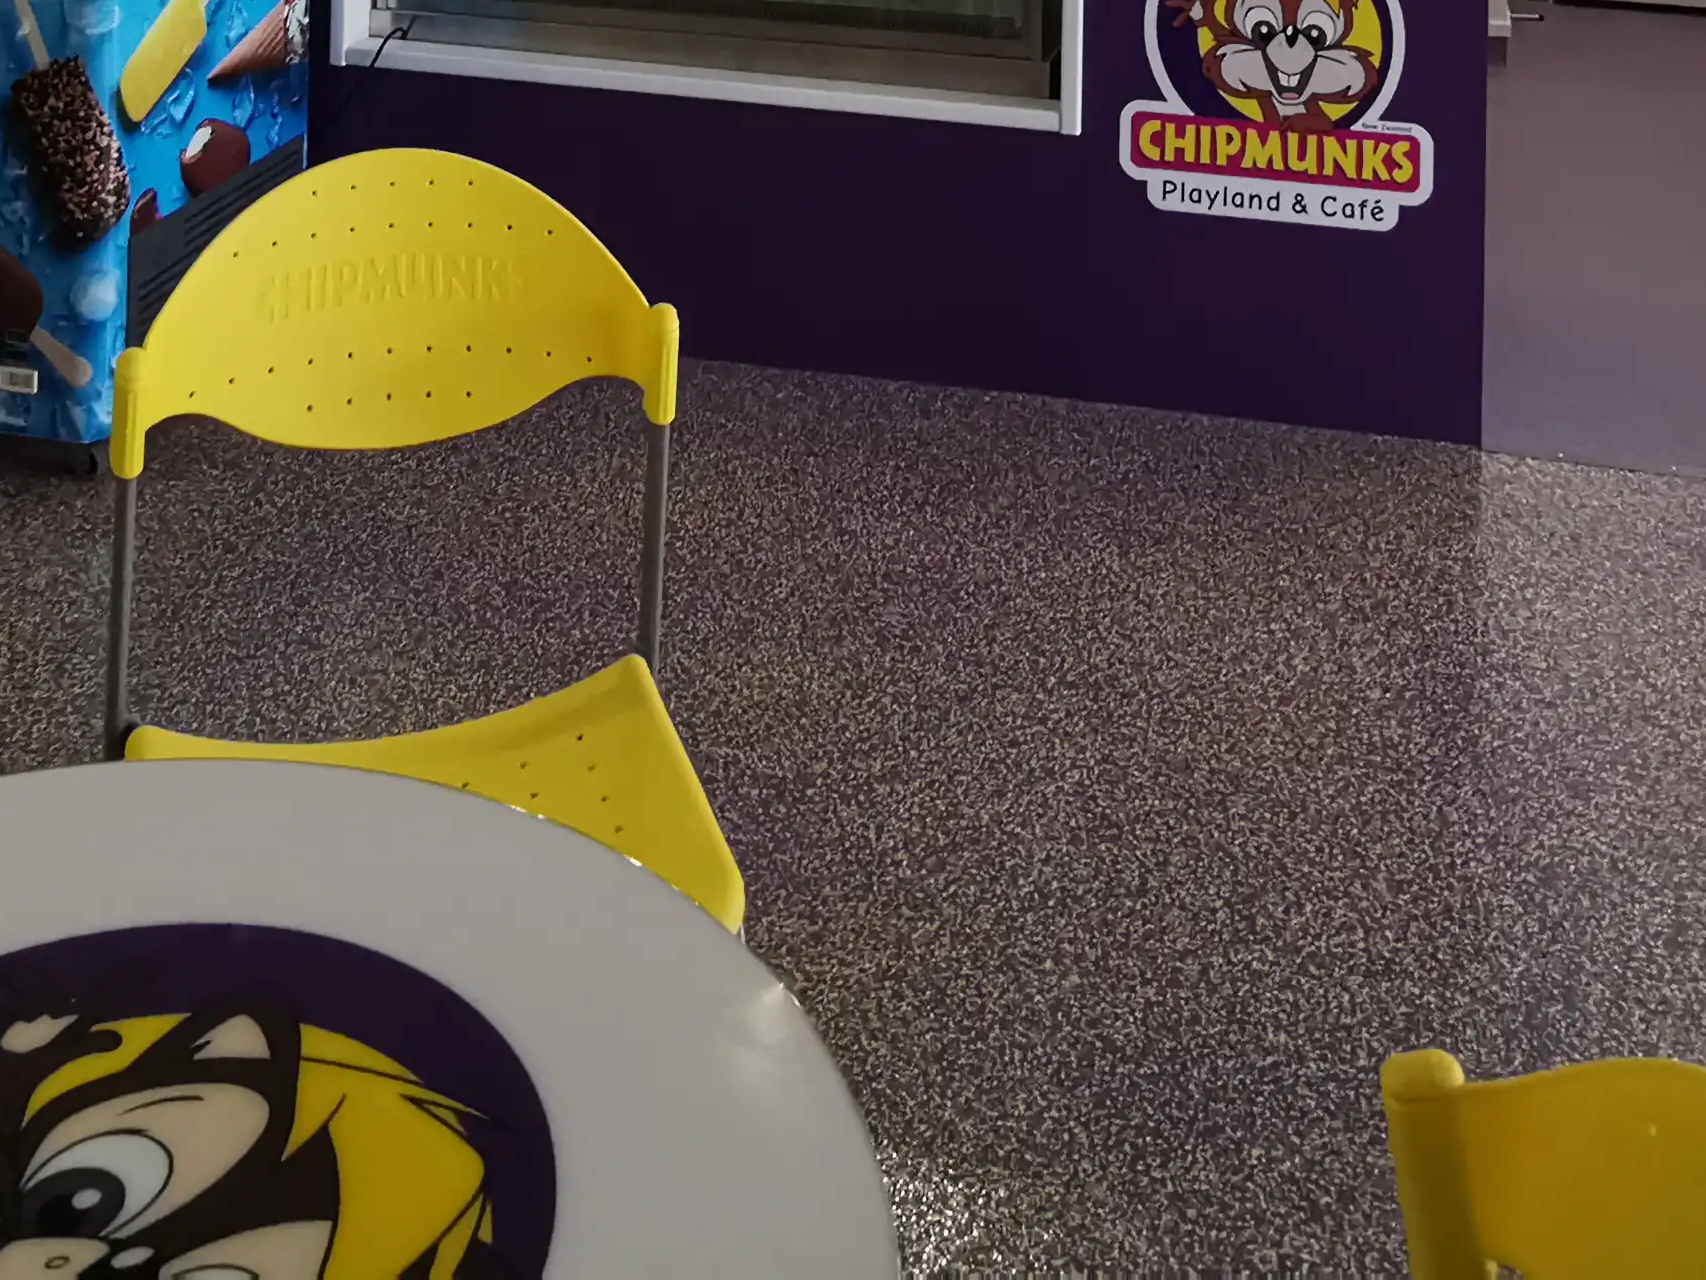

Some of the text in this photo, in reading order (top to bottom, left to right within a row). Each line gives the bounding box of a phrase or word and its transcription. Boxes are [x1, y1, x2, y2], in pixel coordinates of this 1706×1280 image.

[1138, 119, 1414, 184] CHIPMUNKS
[1161, 180, 1385, 222] Playland & Café
[253, 251, 527, 321] CHIPMUNKS
